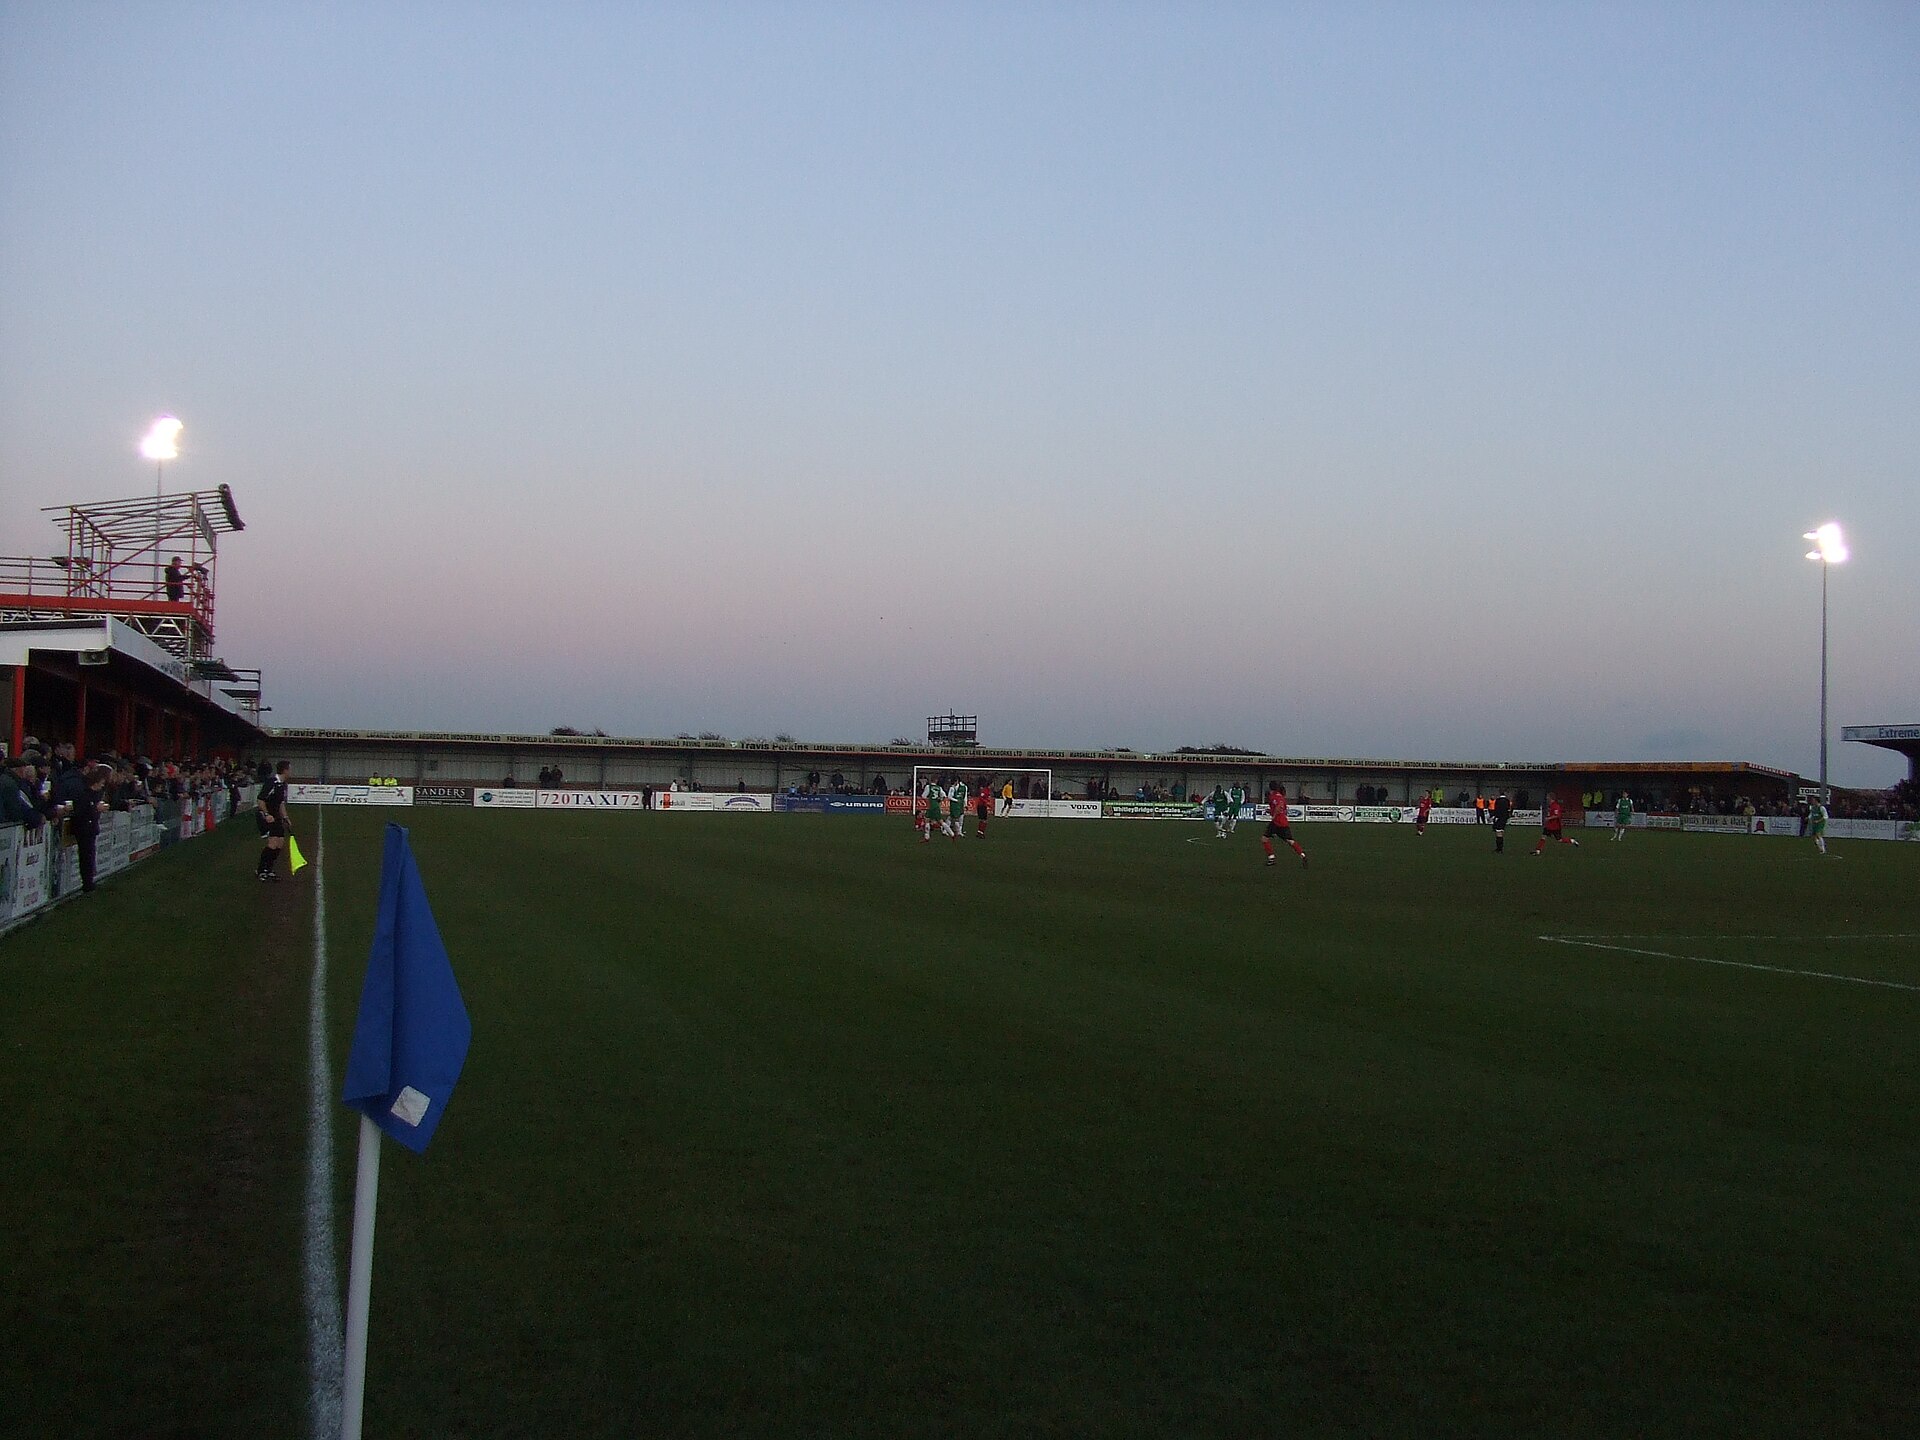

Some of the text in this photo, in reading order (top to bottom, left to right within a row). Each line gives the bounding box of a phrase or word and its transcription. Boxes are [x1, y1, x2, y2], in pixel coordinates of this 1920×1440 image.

[1878, 727, 1920, 739] Extreme
[741, 742, 809, 751] Travis Perkins
[415, 788, 466, 798] SANDERS
[541, 793, 640, 806] 720TAXI72
[888, 797, 927, 807] GOSDNS
